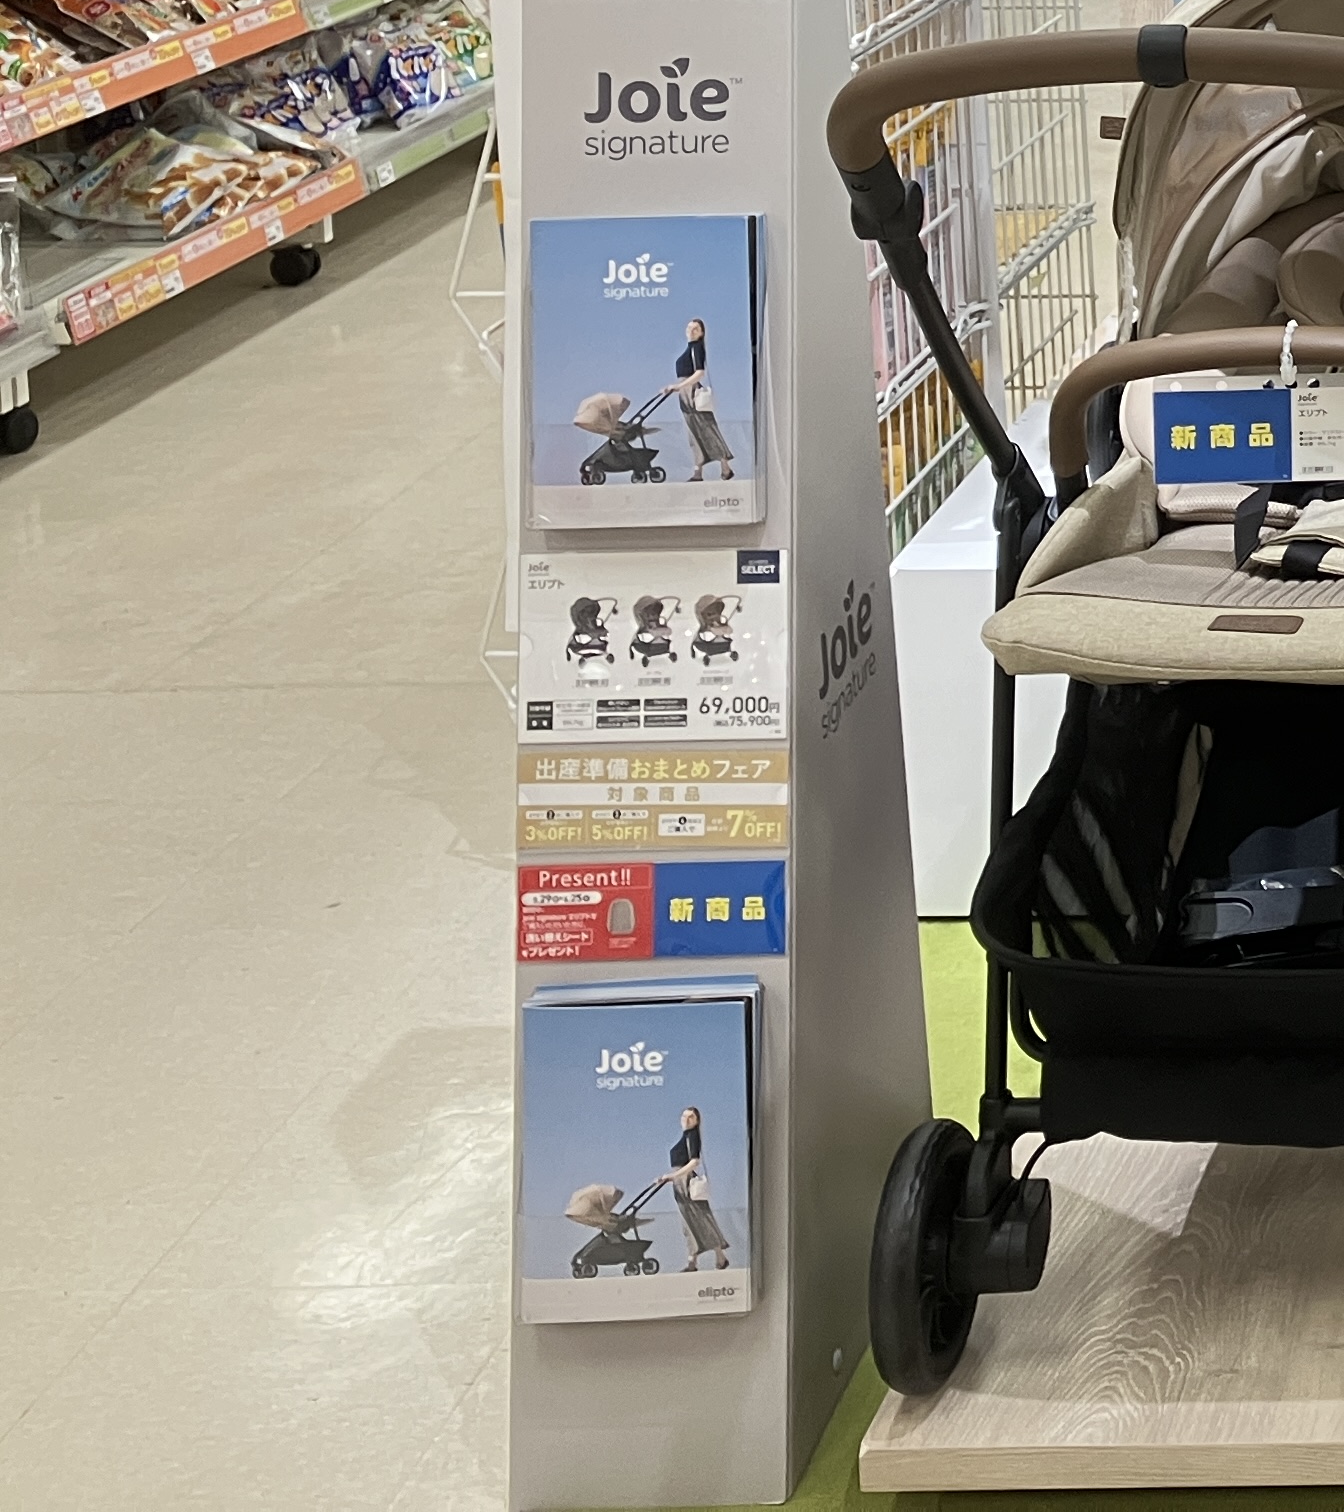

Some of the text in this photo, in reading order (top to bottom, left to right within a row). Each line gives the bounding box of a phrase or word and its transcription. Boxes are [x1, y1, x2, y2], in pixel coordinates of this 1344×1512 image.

[584, 58, 730, 123] Joie
[584, 130, 729, 160] signature
[603, 253, 668, 284] Joie
[603, 286, 669, 300] signature
[1170, 422, 1274, 450] 新商品
[741, 565, 776, 574] SELECT
[819, 578, 872, 700] Joie
[699, 696, 779, 714] 69,000円
[535, 758, 771, 781] 出産準備おまとめフェア
[538, 869, 631, 887] Present!!
[670, 896, 766, 922] 新商品
[595, 1042, 664, 1074] Joie
[596, 1074, 664, 1090] signature
